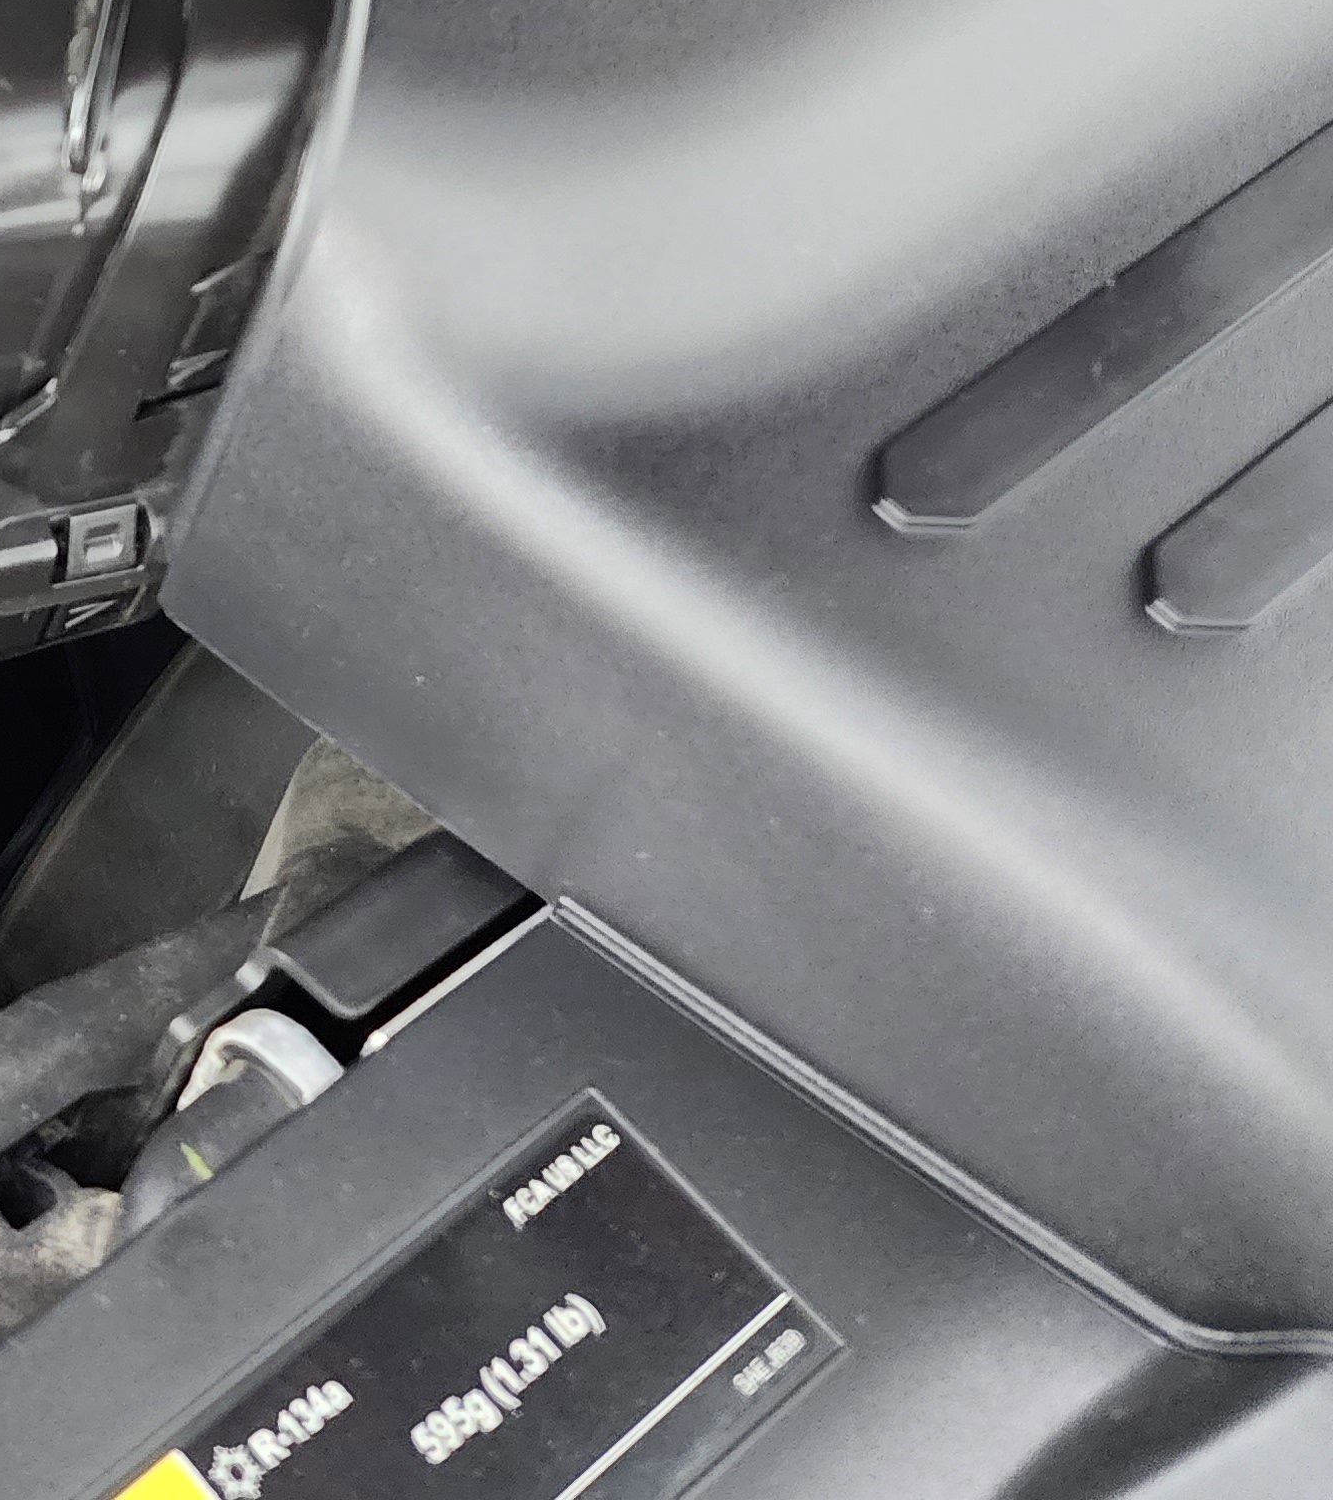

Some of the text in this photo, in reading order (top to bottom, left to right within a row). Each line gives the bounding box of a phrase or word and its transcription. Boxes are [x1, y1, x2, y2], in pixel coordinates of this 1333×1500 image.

[571, 1123, 621, 1170] LLC
[410, 1388, 503, 1465] 595g
[542, 1292, 607, 1348] lb)
